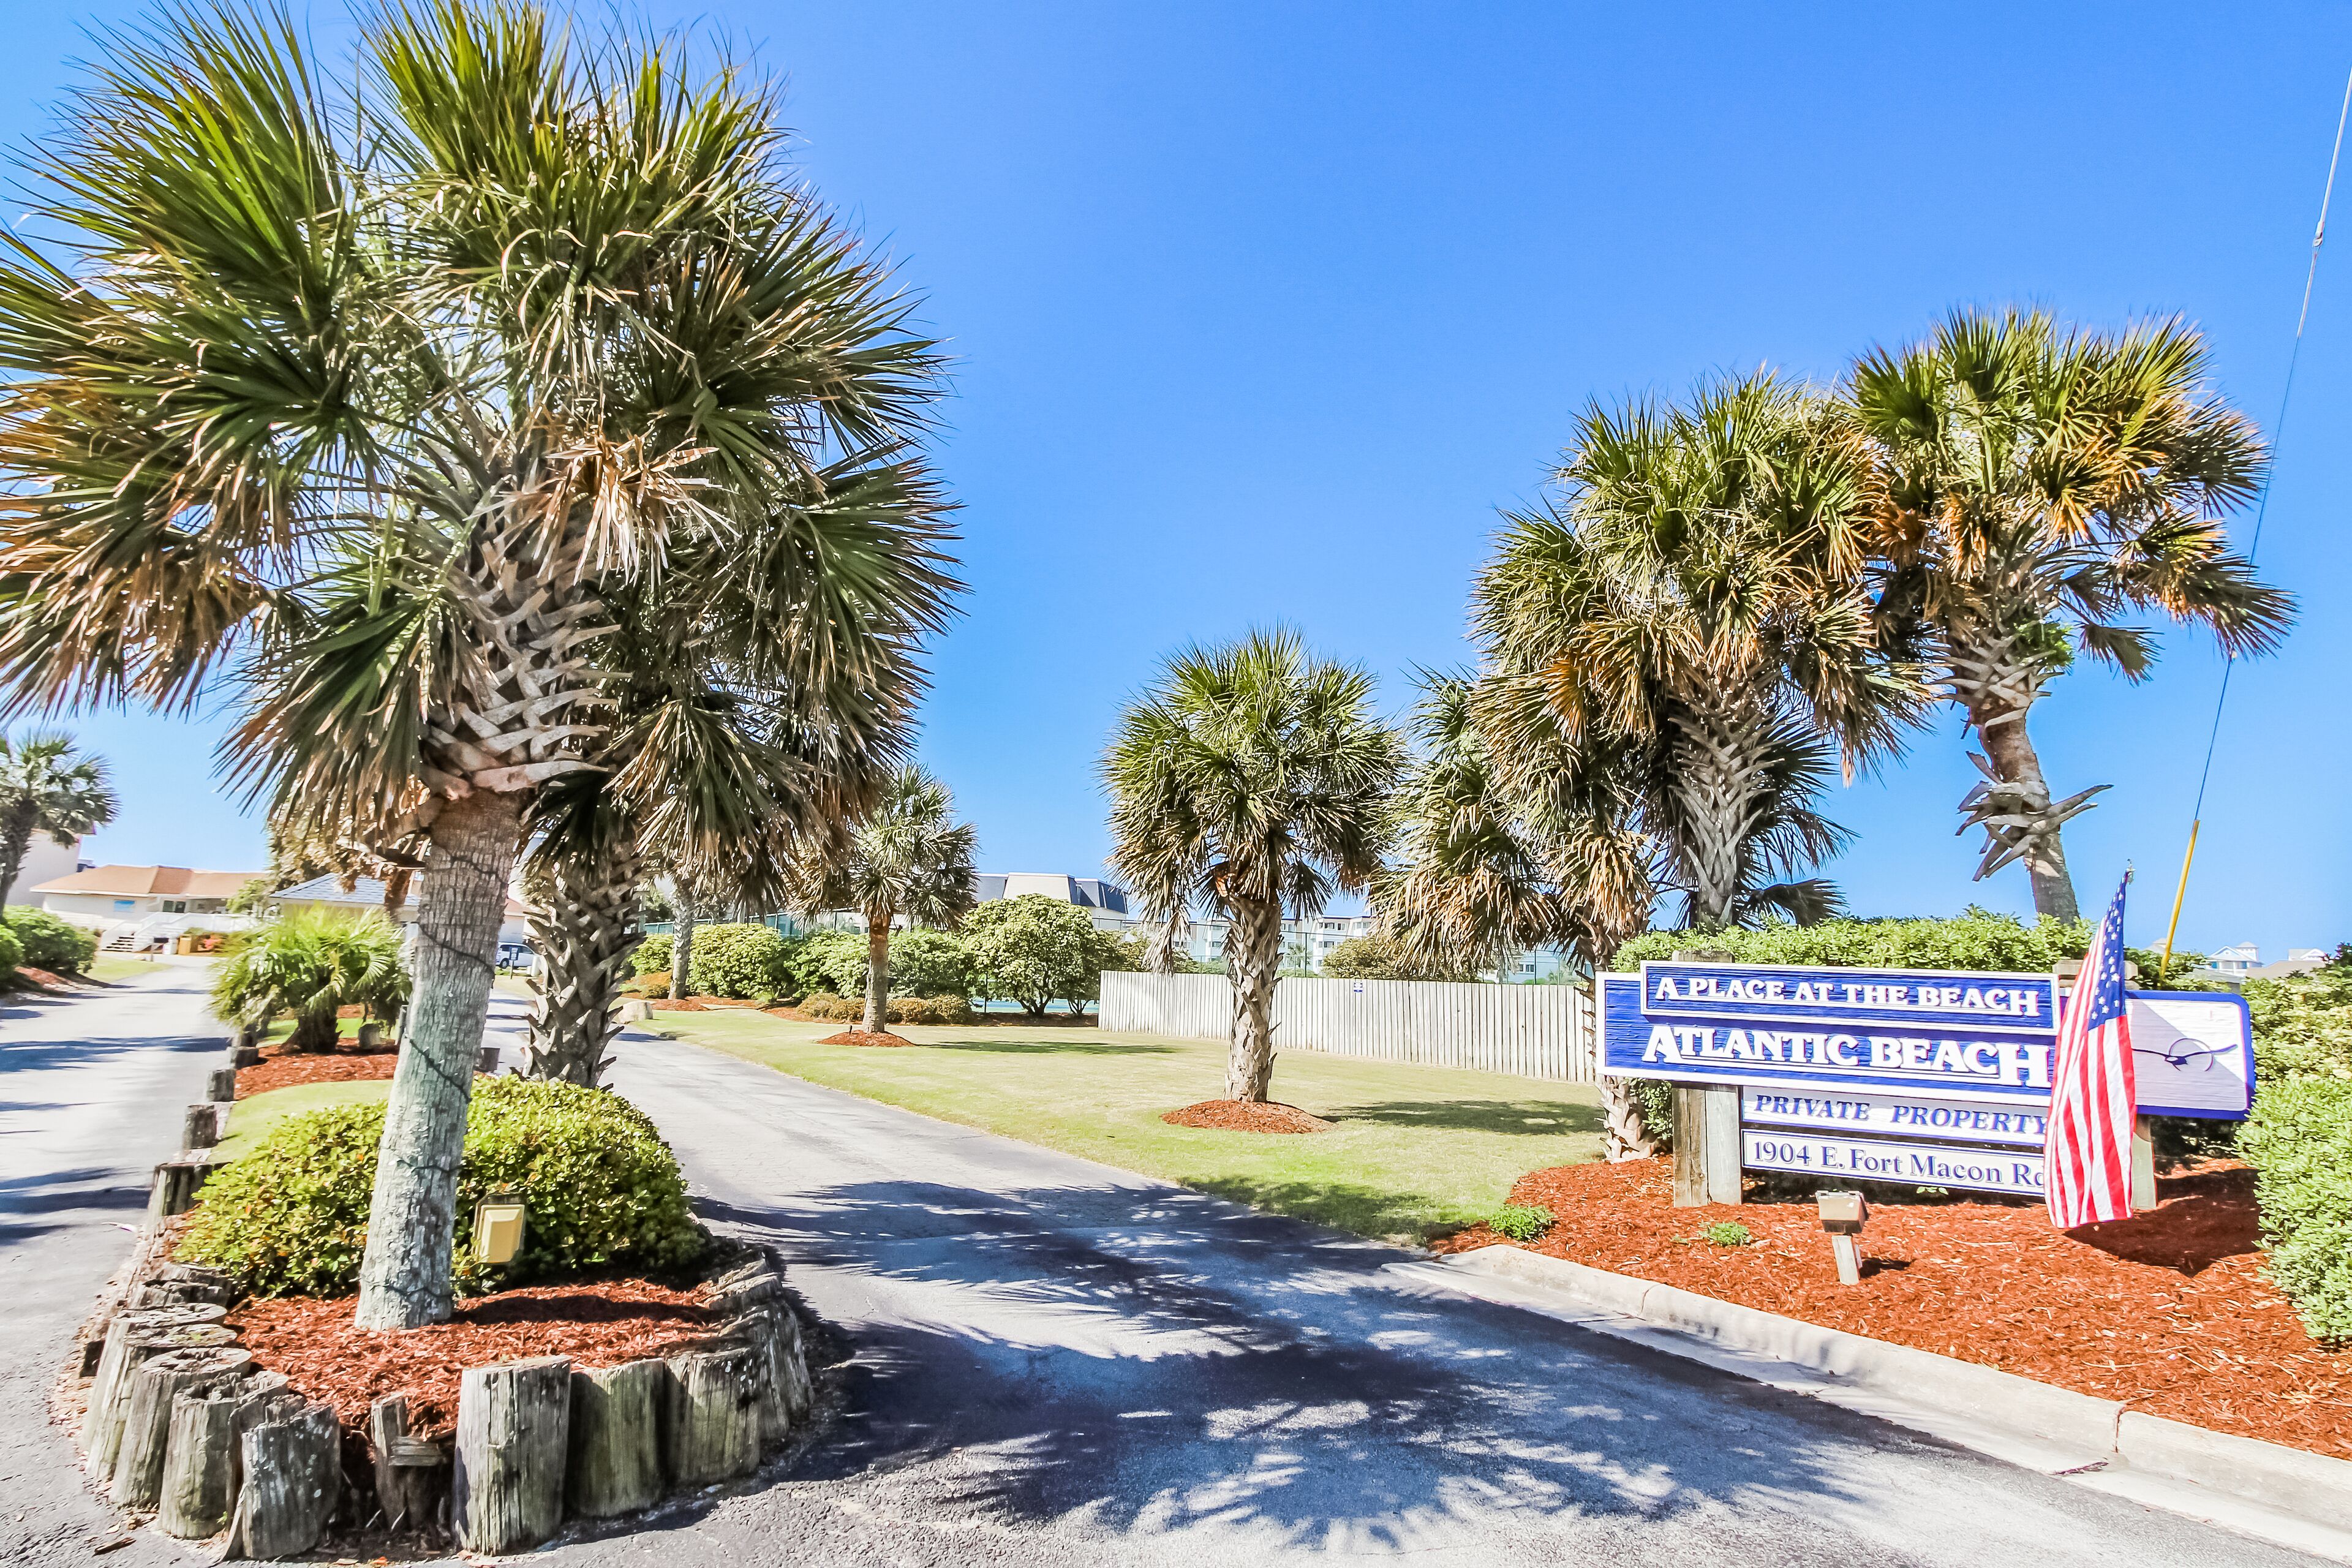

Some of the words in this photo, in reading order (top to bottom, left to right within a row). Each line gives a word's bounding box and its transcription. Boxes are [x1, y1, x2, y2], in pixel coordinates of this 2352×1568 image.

[1655, 977, 1681, 1000] A
[1688, 977, 1785, 1000] PLACE
[1793, 982, 1834, 1001] AT
[1841, 984, 1909, 1005] THE
[1917, 986, 2041, 1017] BEACH
[1642, 1025, 1858, 1066] ATLANTIC
[1868, 1036, 2052, 1088] BEACH
[1754, 1095, 1870, 1120] PRIVATE
[1890, 1105, 2047, 1135] PROPERTY
[1754, 1141, 1811, 1166] 1904
[1821, 1145, 1845, 1168] E.
[1850, 1148, 1902, 1174] Fort
[1910, 1153, 2003, 1185] Macon
